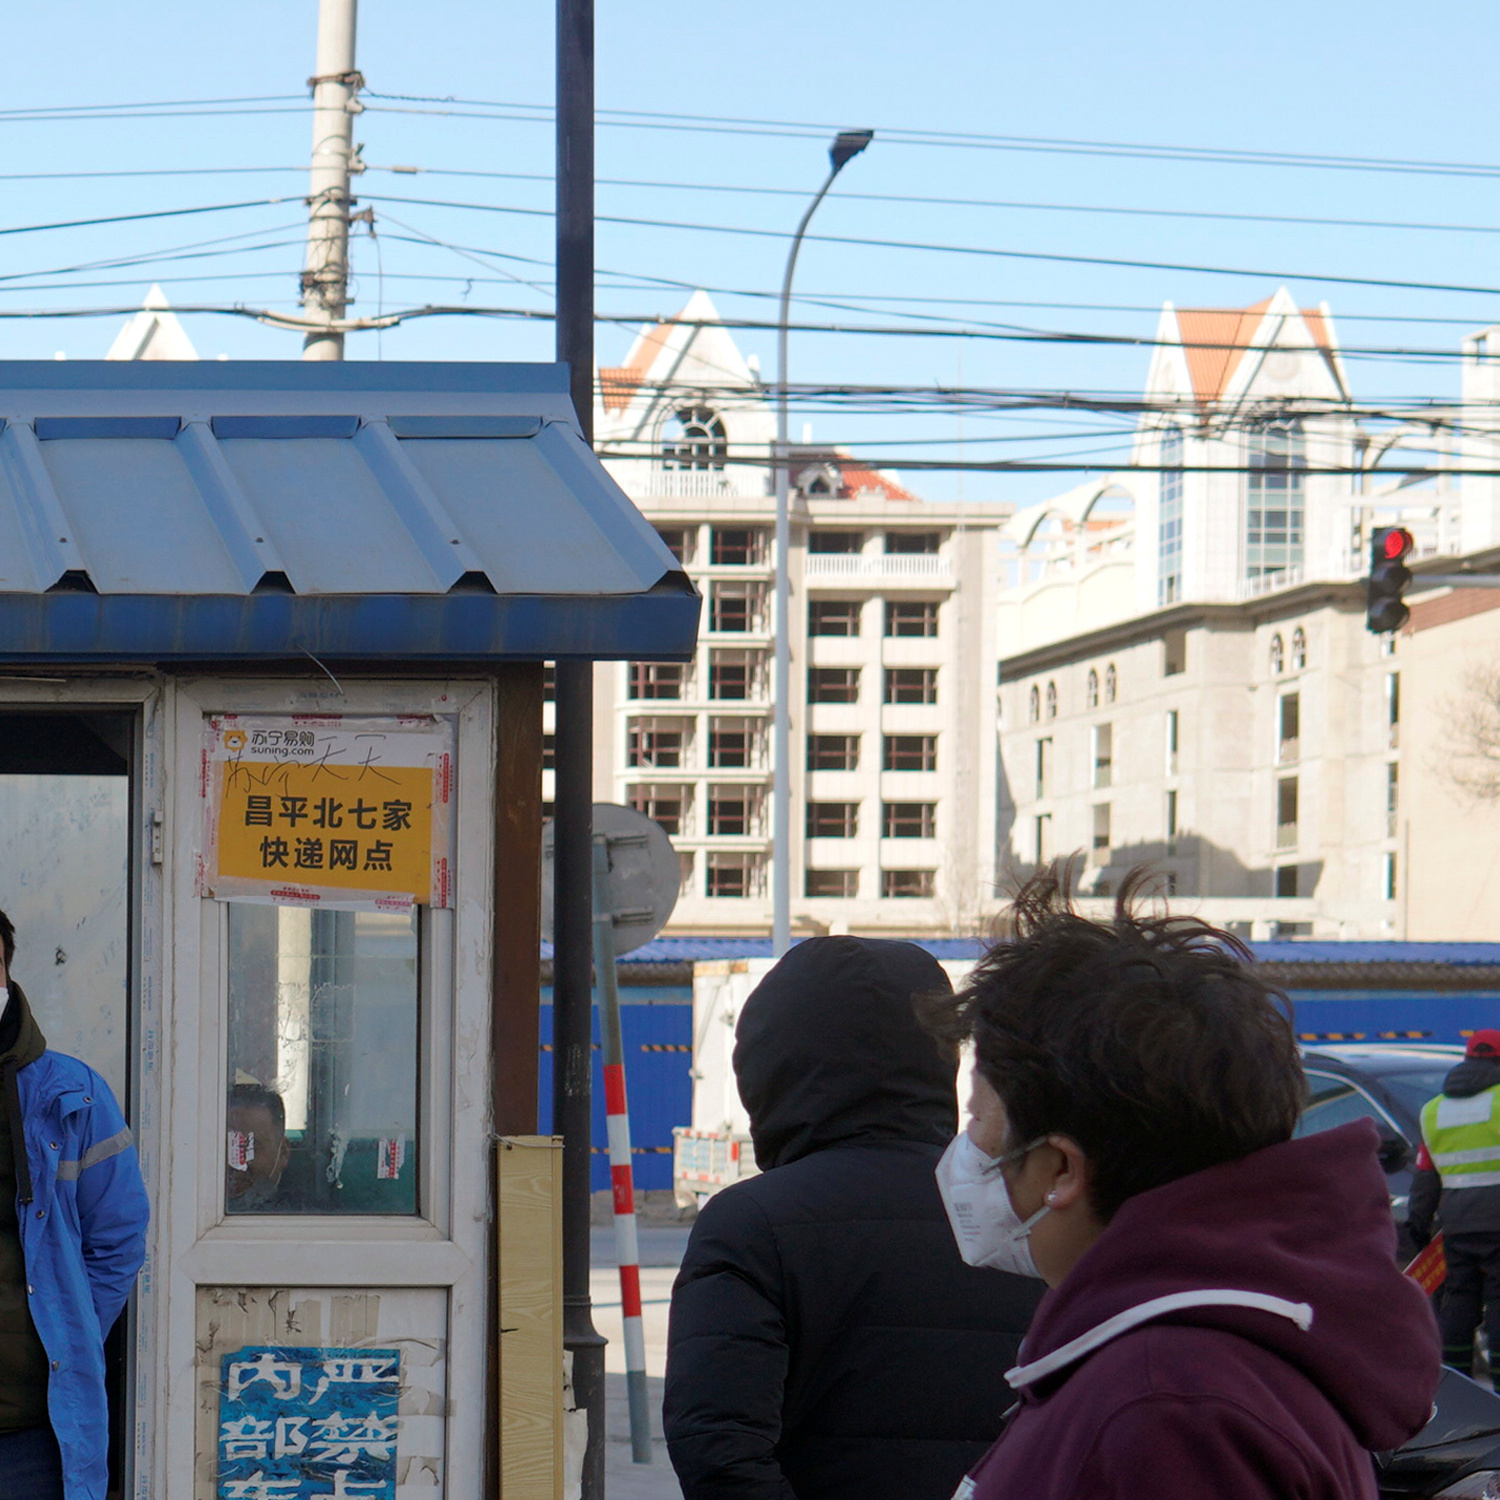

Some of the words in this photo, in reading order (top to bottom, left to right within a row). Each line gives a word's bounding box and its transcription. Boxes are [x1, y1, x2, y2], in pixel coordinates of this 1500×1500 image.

[251, 729, 315, 748] 苏宁易购
[251, 746, 315, 757] suning.com
[244, 795, 413, 831] 昌平北七家
[260, 836, 394, 872] 快递网点
